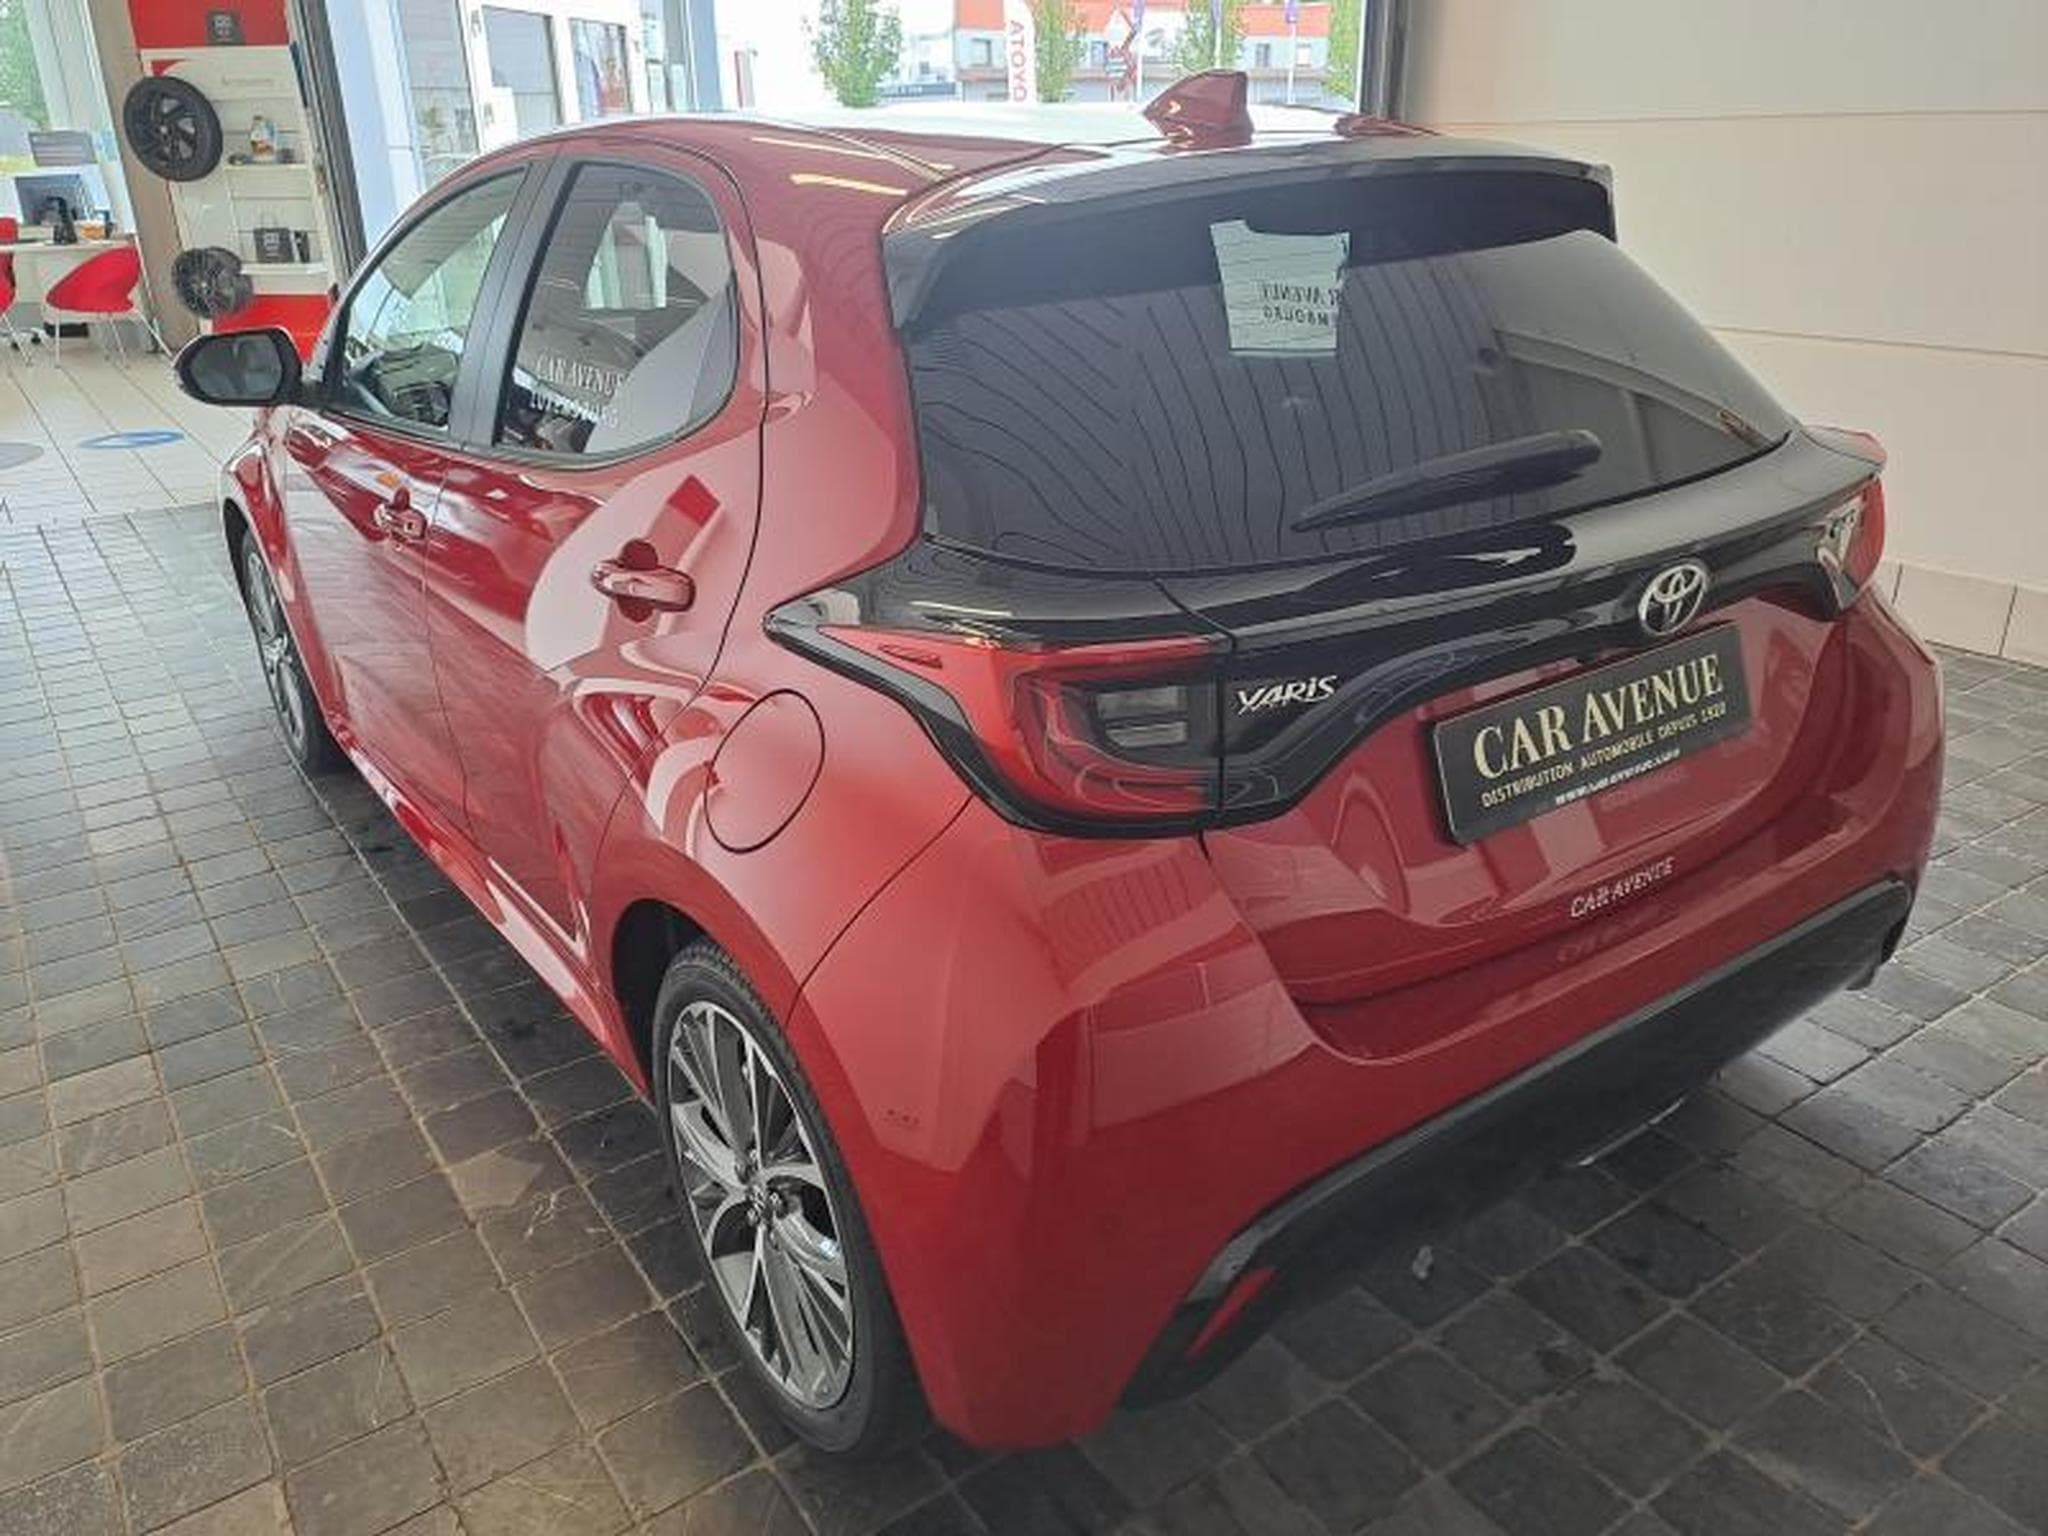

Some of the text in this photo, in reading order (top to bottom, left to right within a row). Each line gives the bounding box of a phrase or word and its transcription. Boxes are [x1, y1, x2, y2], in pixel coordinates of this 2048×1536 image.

[1237, 675, 1338, 716] YARIS
[1473, 653, 1725, 780] CAR AVENUE
[1480, 762, 1573, 807] DISTRIBUTION
[1580, 731, 1654, 770] AUTOMOBILE
[1570, 856, 1676, 917] CAR AVENUE
